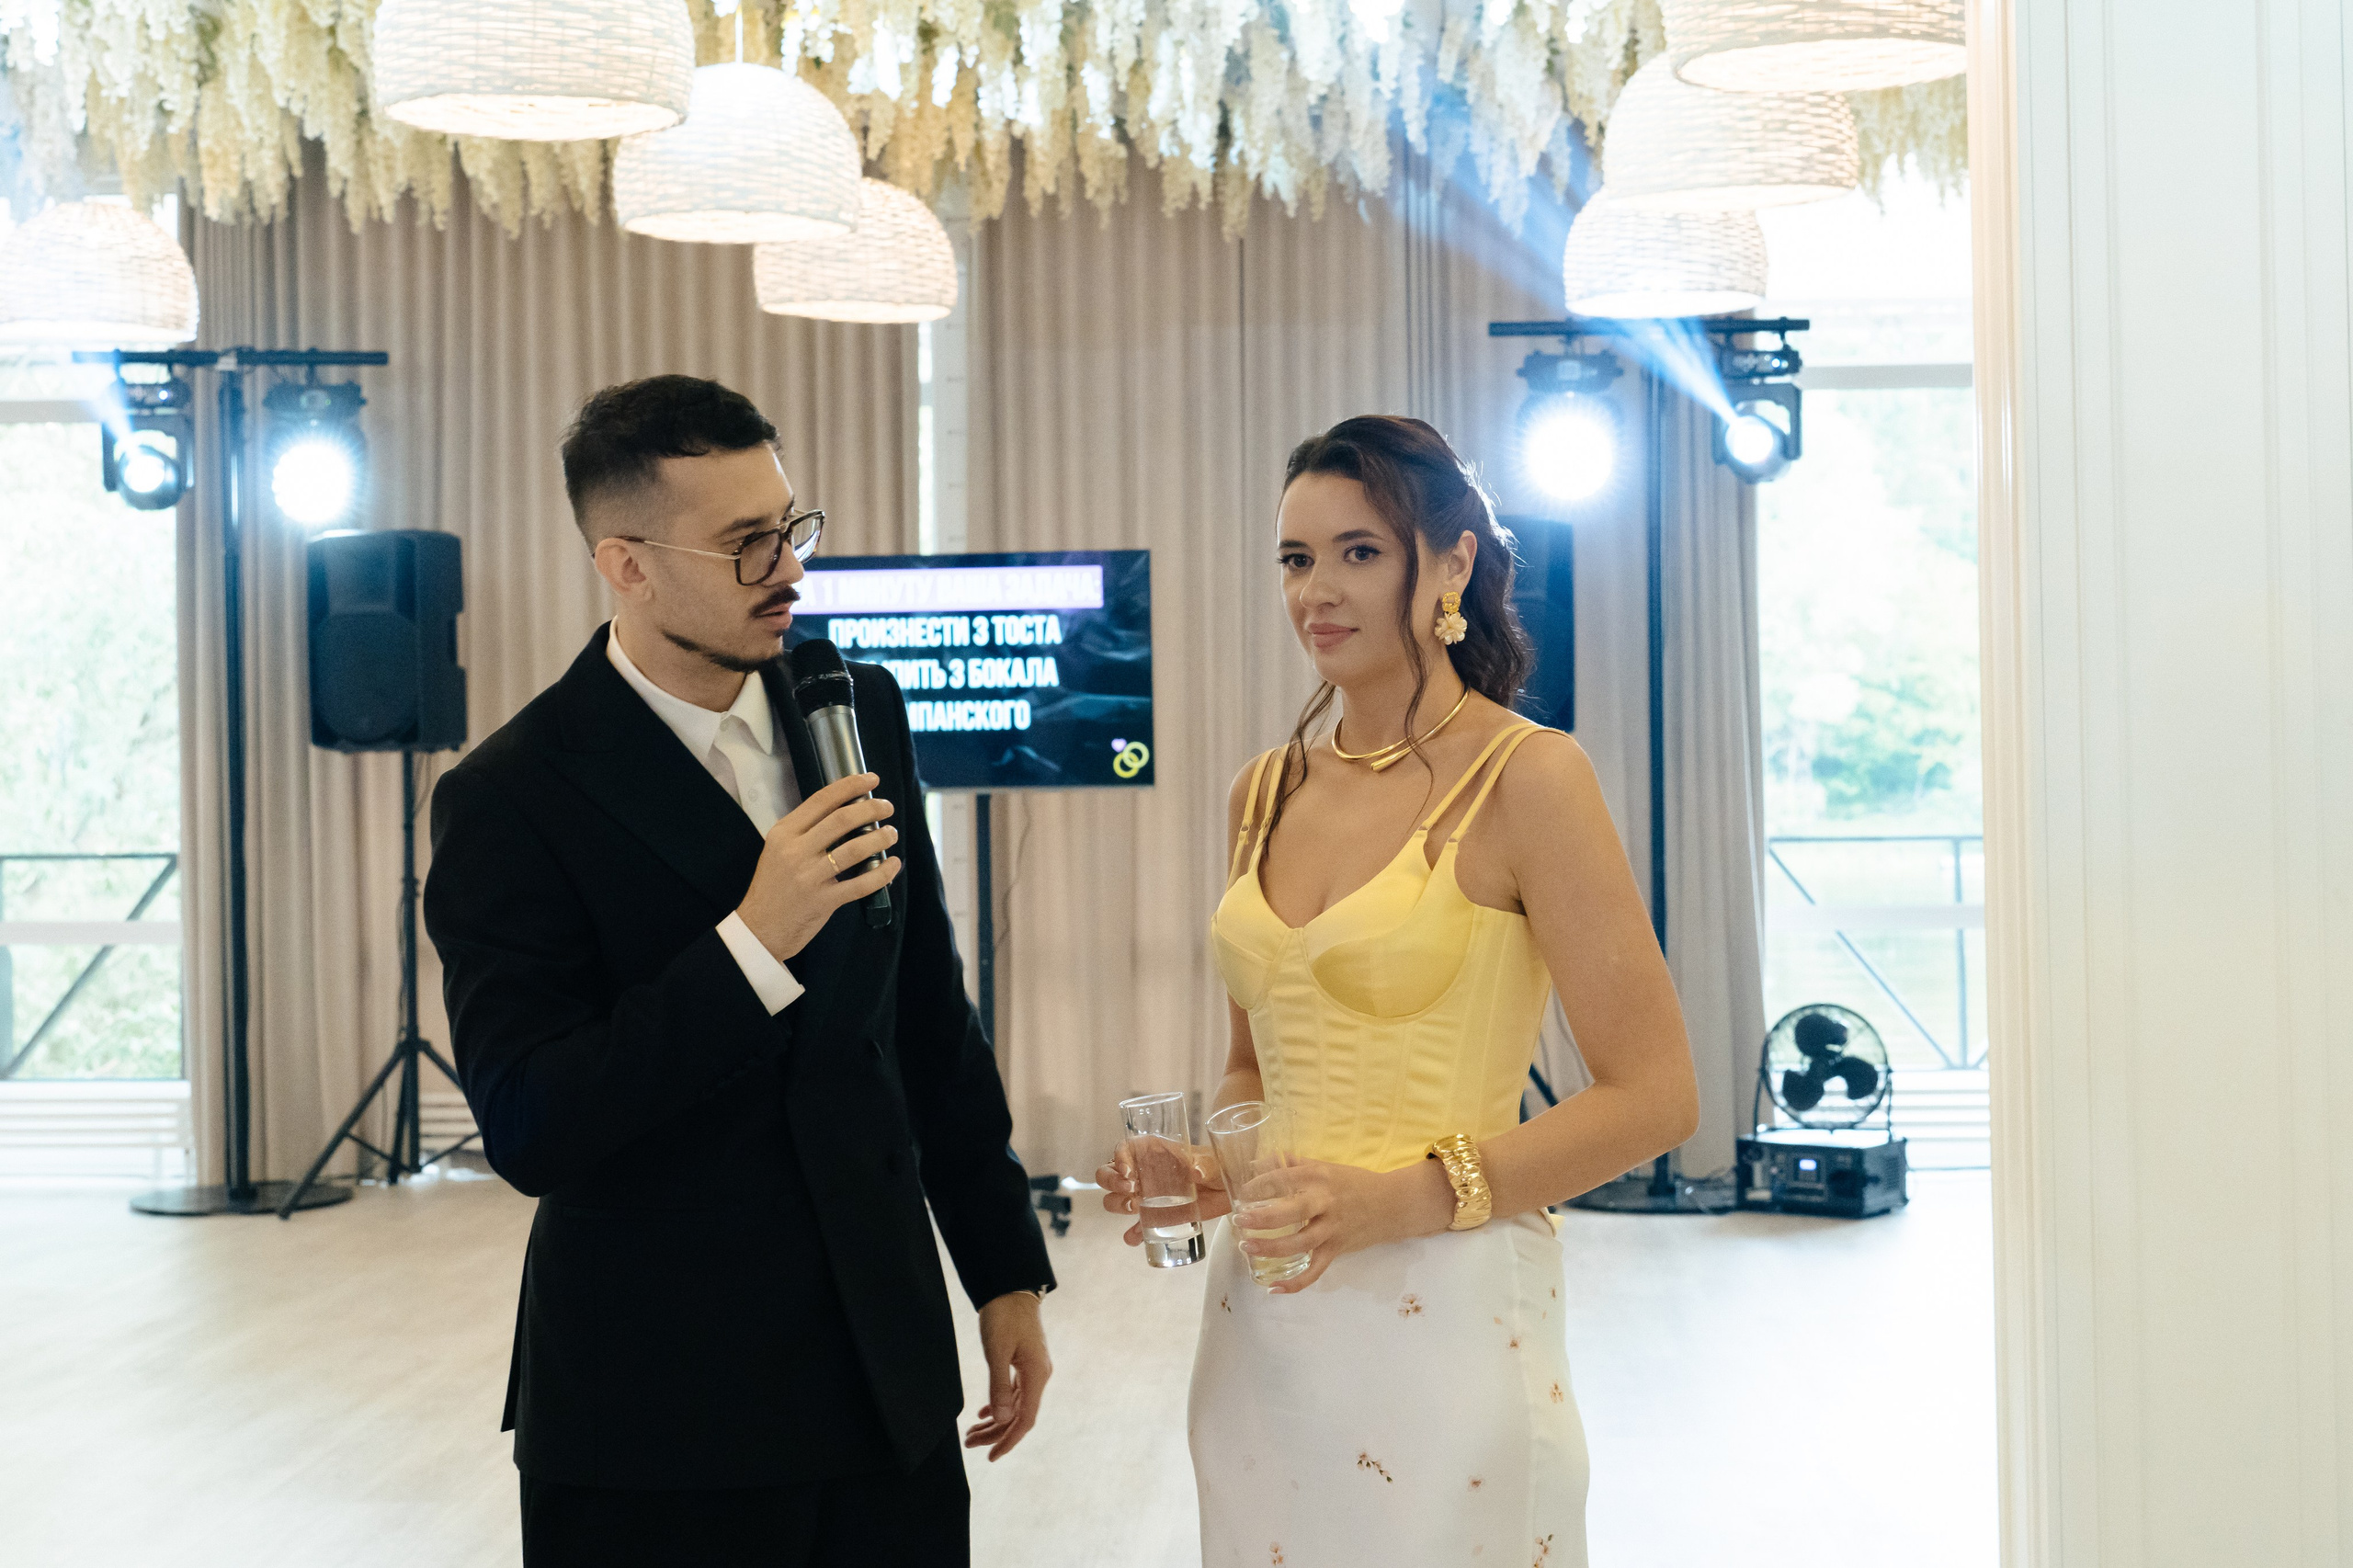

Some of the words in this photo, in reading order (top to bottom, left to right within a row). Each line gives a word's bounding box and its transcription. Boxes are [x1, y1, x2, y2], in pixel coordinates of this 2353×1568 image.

[828, 616, 971, 649] ПРОИЗНЕСТИ
[972, 615, 990, 647] 3
[990, 614, 1063, 646] ТОСТА
[858, 658, 948, 690] ПИТЬ
[948, 657, 966, 689] 3
[967, 656, 1060, 688] БОКАЛА
